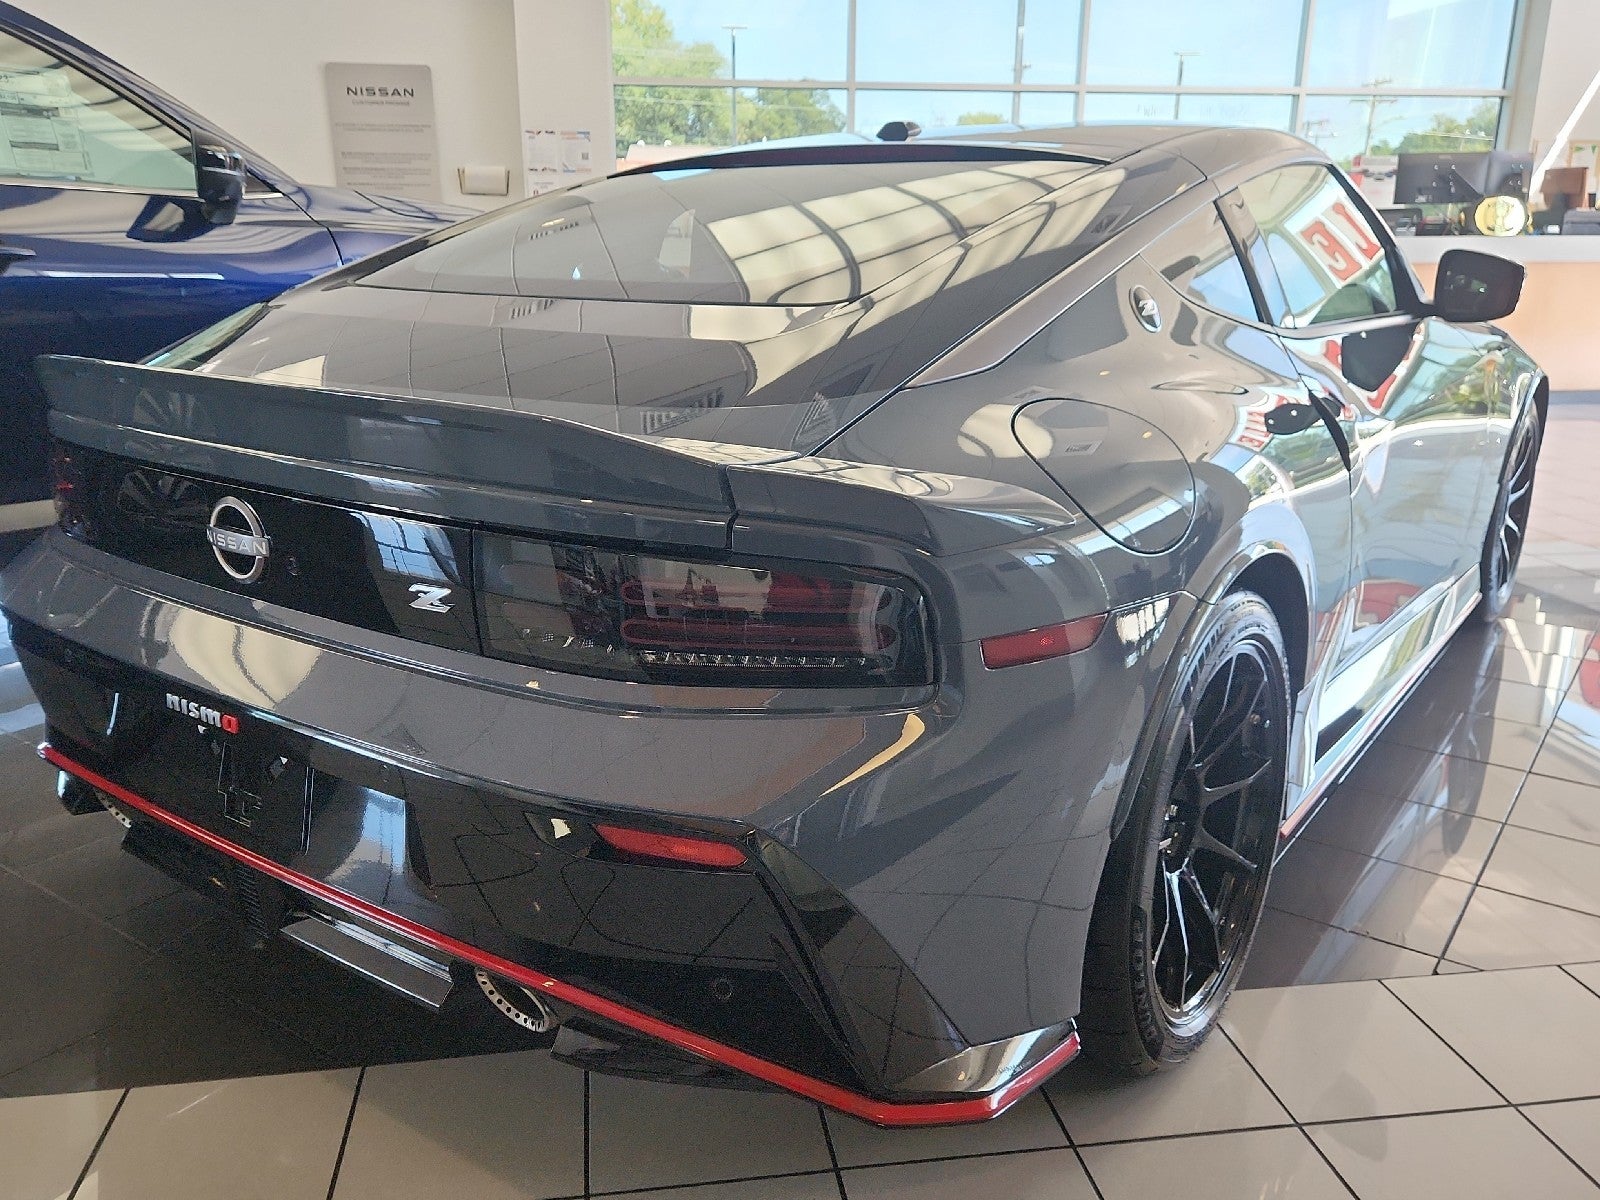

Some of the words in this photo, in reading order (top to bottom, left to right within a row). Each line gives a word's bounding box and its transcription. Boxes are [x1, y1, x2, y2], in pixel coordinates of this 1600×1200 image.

[346, 86, 414, 97] NISSAN
[206, 528, 267, 555] NISSAN
[408, 582, 455, 613] Z
